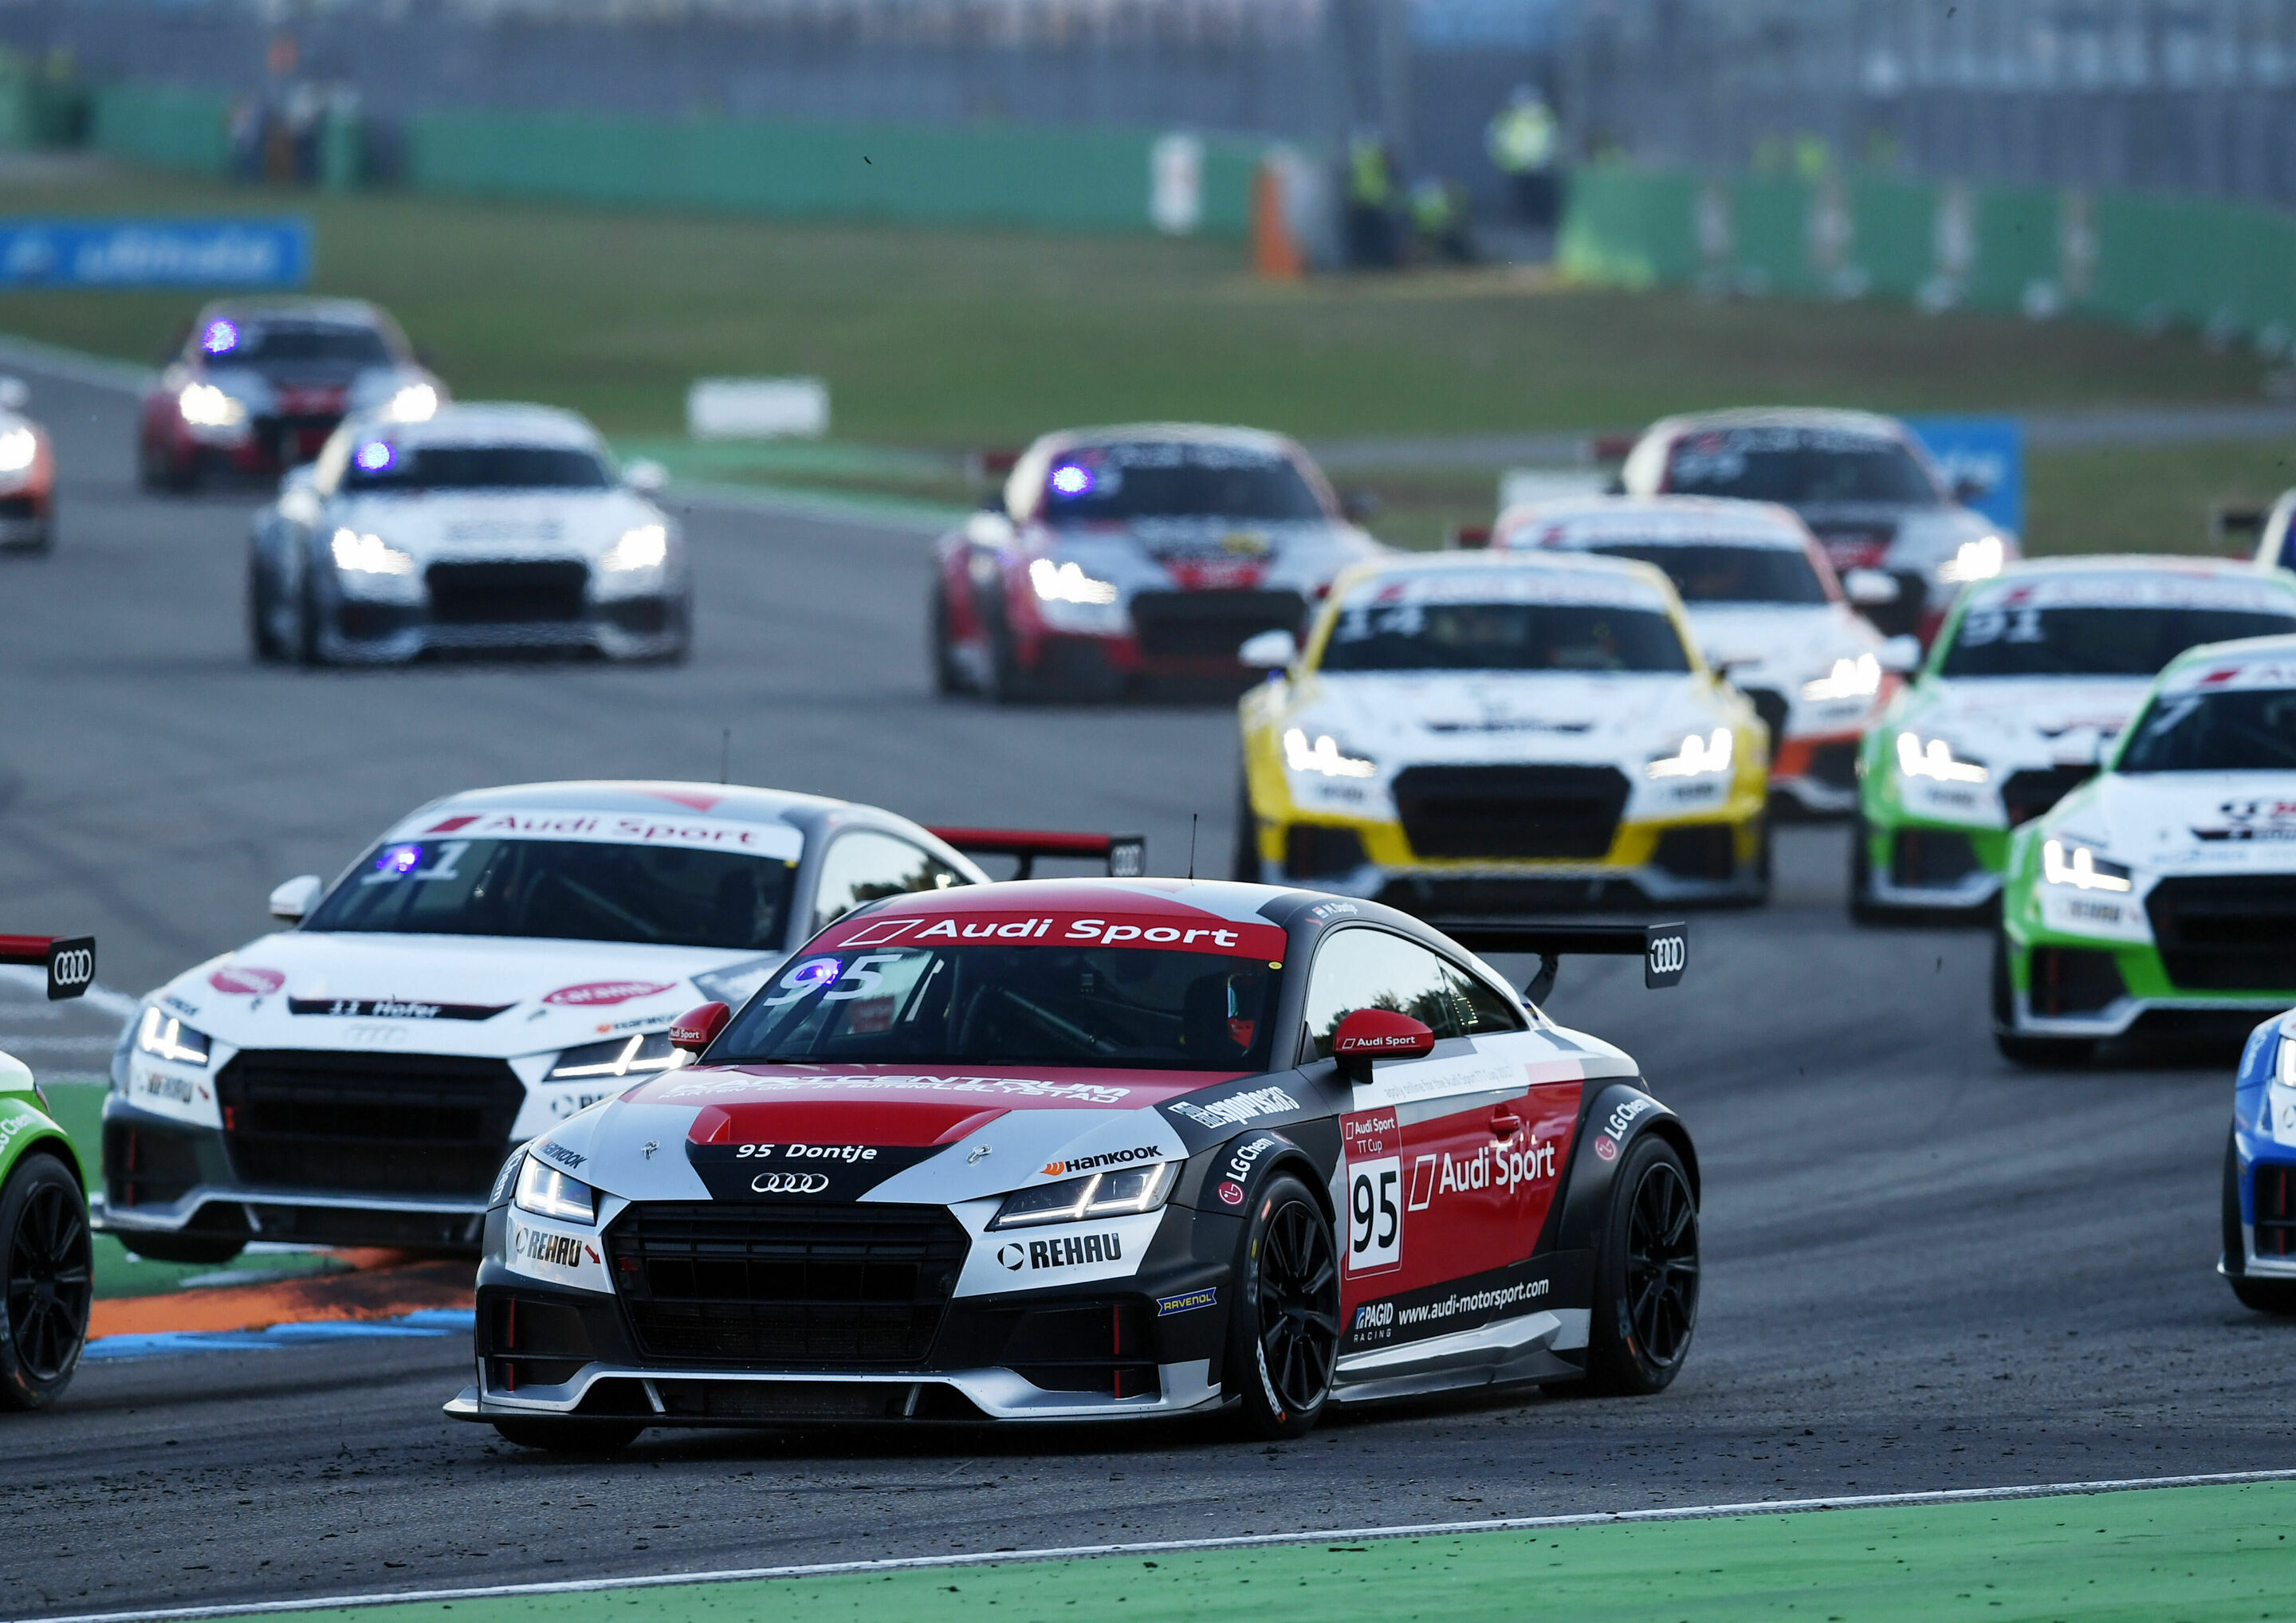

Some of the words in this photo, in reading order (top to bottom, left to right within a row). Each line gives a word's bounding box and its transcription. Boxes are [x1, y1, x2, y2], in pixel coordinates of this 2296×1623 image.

[489, 813, 600, 834] Audi
[619, 816, 759, 847] Sport
[914, 918, 1053, 938] Audi
[1064, 919, 1239, 947] Sport
[763, 953, 903, 1007] 95
[681, 1029, 700, 1039] Sport
[1357, 1037, 1382, 1046] Audi
[1386, 1036, 1416, 1047] Sport
[667, 1075, 1131, 1098] KARTCENTRUM
[931, 1083, 1119, 1104] LELYSTAD
[1205, 1086, 1300, 1126] sportscars
[1355, 1120, 1372, 1135] Audi
[1373, 1117, 1396, 1134] Sport
[1604, 1114, 1628, 1142] LG
[736, 1144, 776, 1158] 95
[785, 1144, 878, 1164] Dontje
[1236, 1138, 1276, 1161] Chem
[1357, 1140, 1367, 1154] TT
[1368, 1140, 1383, 1154] Cup
[1226, 1157, 1251, 1183] LG
[1438, 1146, 1489, 1195] Audi
[1496, 1141, 1555, 1195] Sport
[1353, 1170, 1398, 1253] 95
[527, 1230, 583, 1267] REHAU
[1028, 1232, 1122, 1270] REHAU
[1164, 1294, 1212, 1311] RAVENOL
[1398, 1279, 1549, 1326] www.audi-motorsport.com
[1364, 1303, 1394, 1329] PAGID
[1353, 1328, 1392, 1343] RACING
